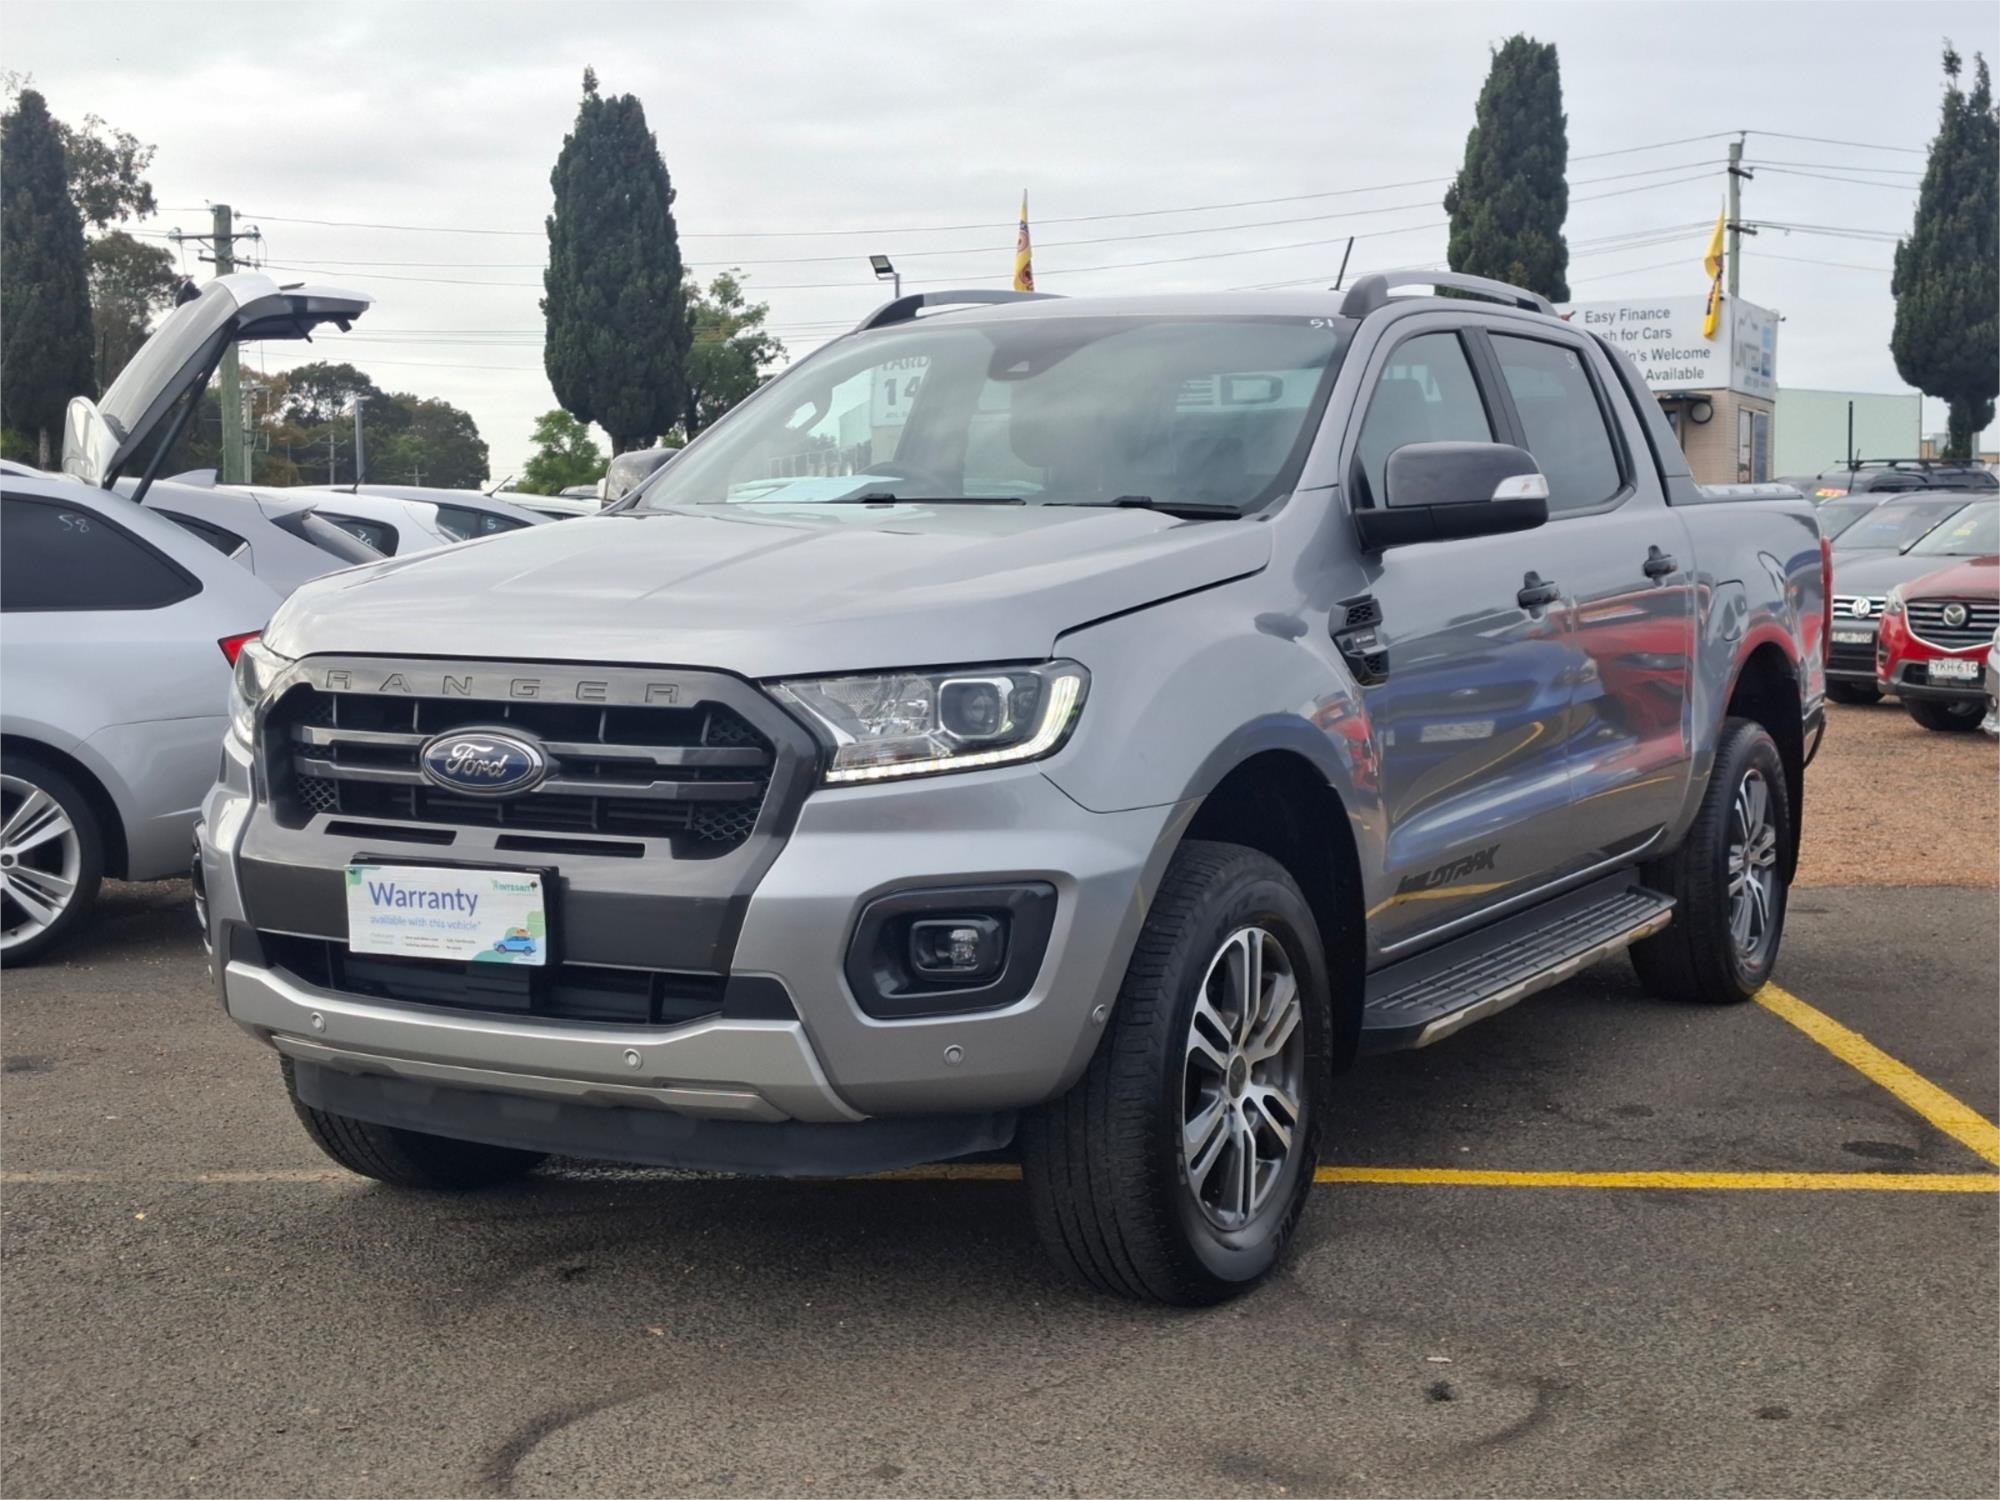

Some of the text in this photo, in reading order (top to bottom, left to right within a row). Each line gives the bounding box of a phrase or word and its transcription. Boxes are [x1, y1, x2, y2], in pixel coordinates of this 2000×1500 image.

[1310, 318, 1334, 329] 51
[1584, 307, 1671, 326] Easy Finance
[1621, 327, 1639, 341] for
[1642, 326, 1673, 340] Cars
[1650, 347, 1711, 362] Welcome
[1645, 366, 1705, 382] Available
[58, 513, 91, 534] 58
[325, 669, 680, 704] RANGER
[445, 742, 509, 778] Ford
[368, 881, 479, 917] Warranty
[370, 915, 405, 926] available
[407, 917, 427, 928] with
[429, 918, 445, 929] this
